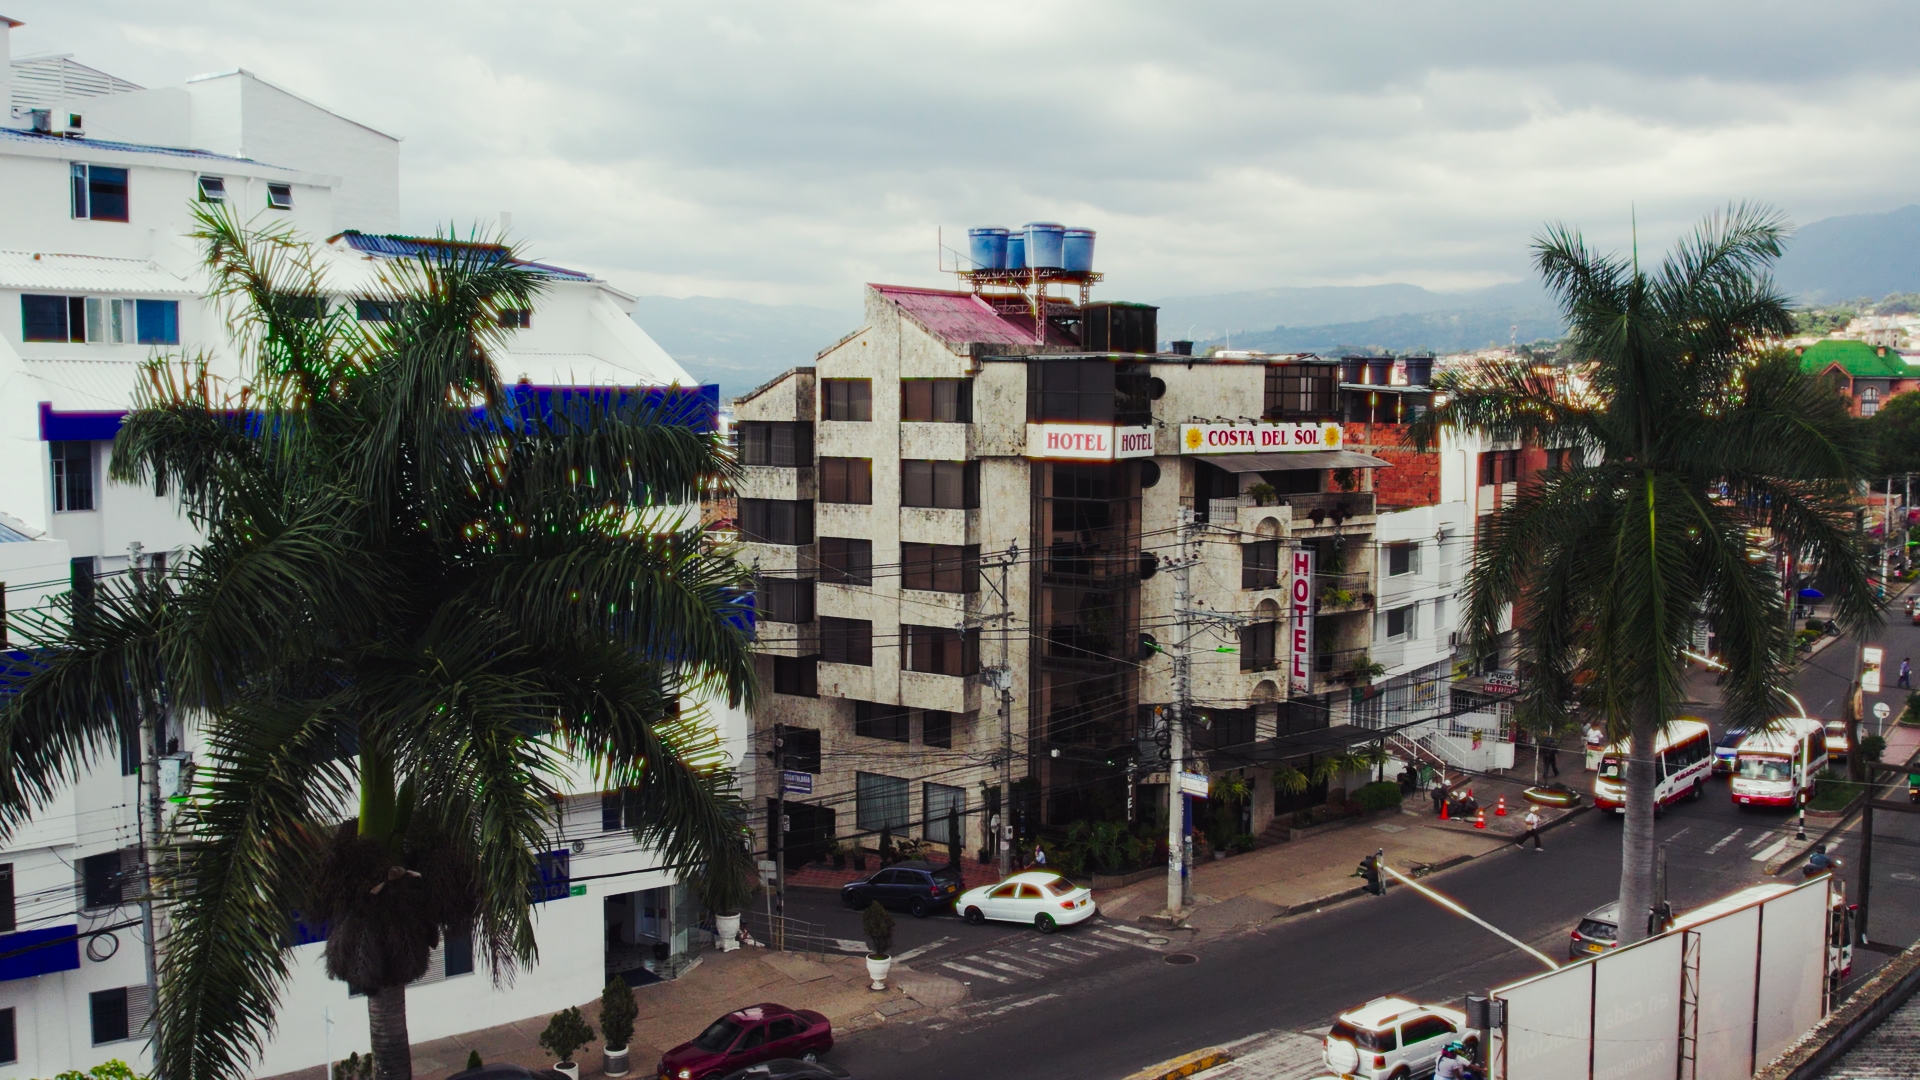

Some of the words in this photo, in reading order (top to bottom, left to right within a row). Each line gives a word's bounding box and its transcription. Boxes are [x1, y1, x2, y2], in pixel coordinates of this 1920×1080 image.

[1047, 432, 1107, 451] HOTEL
[1121, 433, 1153, 451] HOTEL
[1208, 430, 1255, 446] COSTA
[1261, 430, 1288, 446] DEL
[1294, 429, 1320, 445] SOL
[1293, 552, 1309, 678] HOTEL
